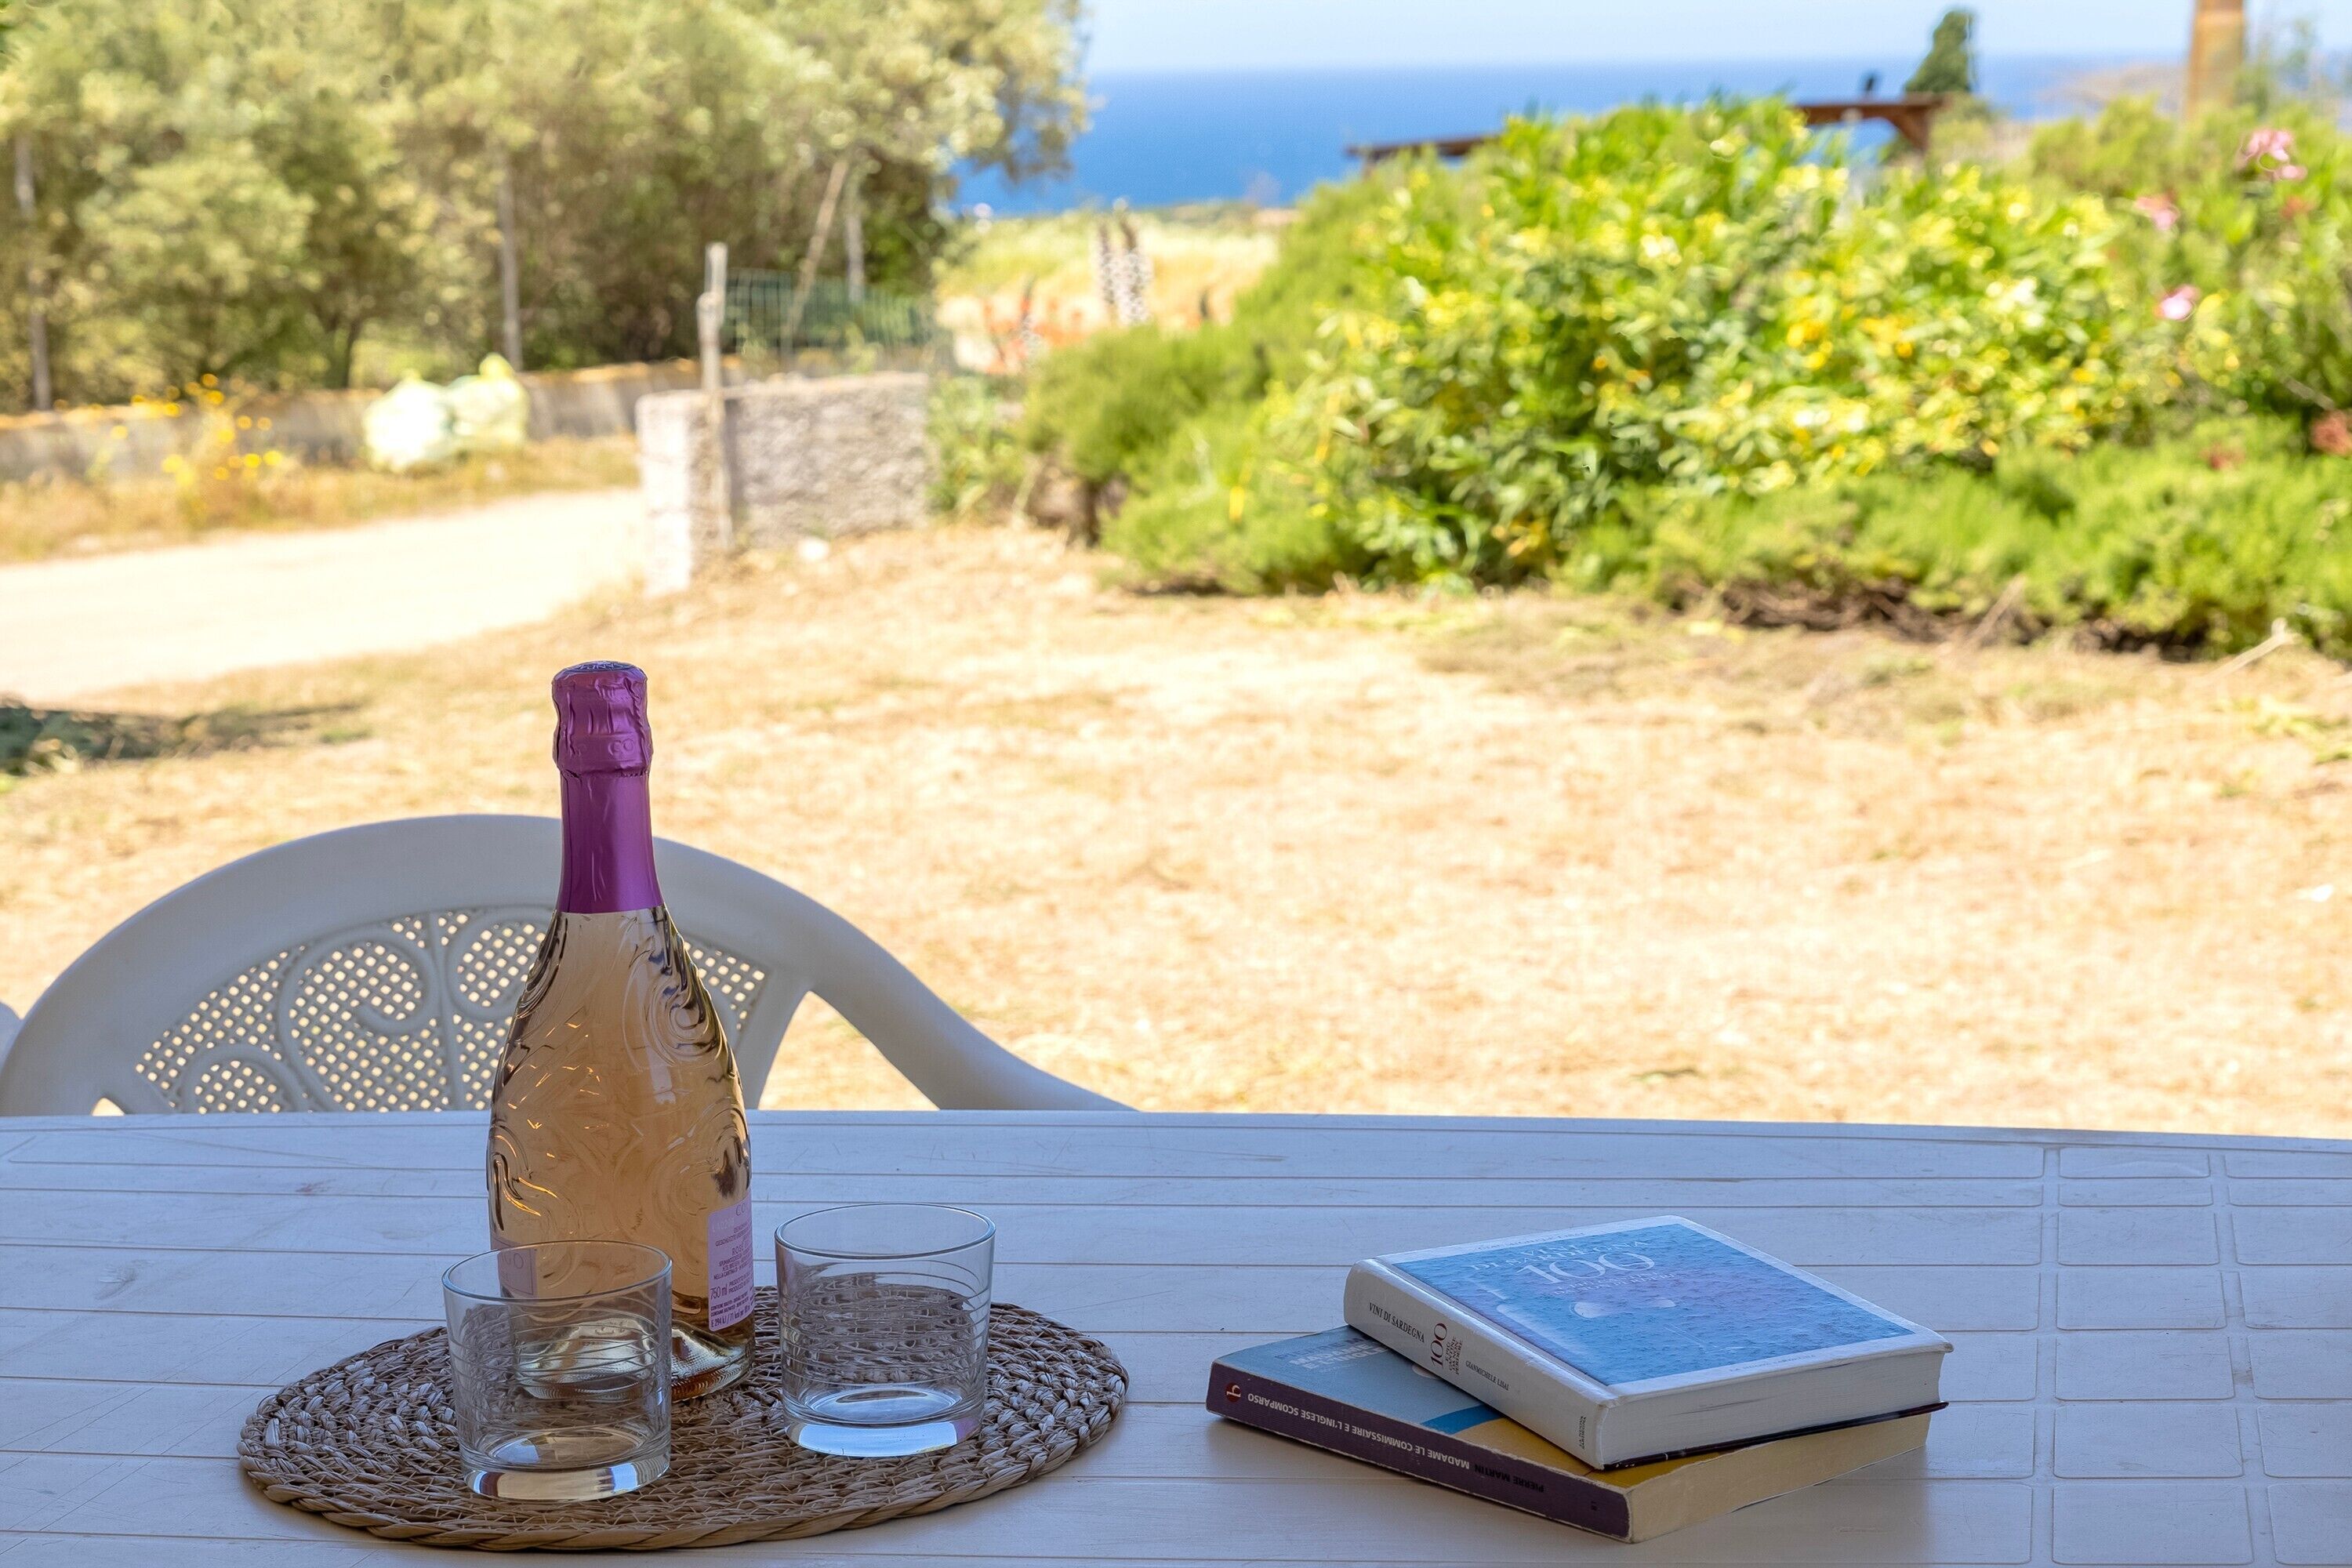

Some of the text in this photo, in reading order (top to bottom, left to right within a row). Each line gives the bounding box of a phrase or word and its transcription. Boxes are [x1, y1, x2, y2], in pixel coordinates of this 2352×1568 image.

[1516, 1252, 1656, 1284] 100
[710, 1286, 721, 1300] 750
[1368, 1301, 1425, 1344] VINI DI SARDEGNA
[1430, 1323, 1448, 1368] 100
[1465, 1359, 1497, 1385] GIANMICHELE
[1247, 1392, 1545, 1494] PIERRE MARTIN MADAME LE COMMISSAIRE E L'INGLESE SCOMPARSO
